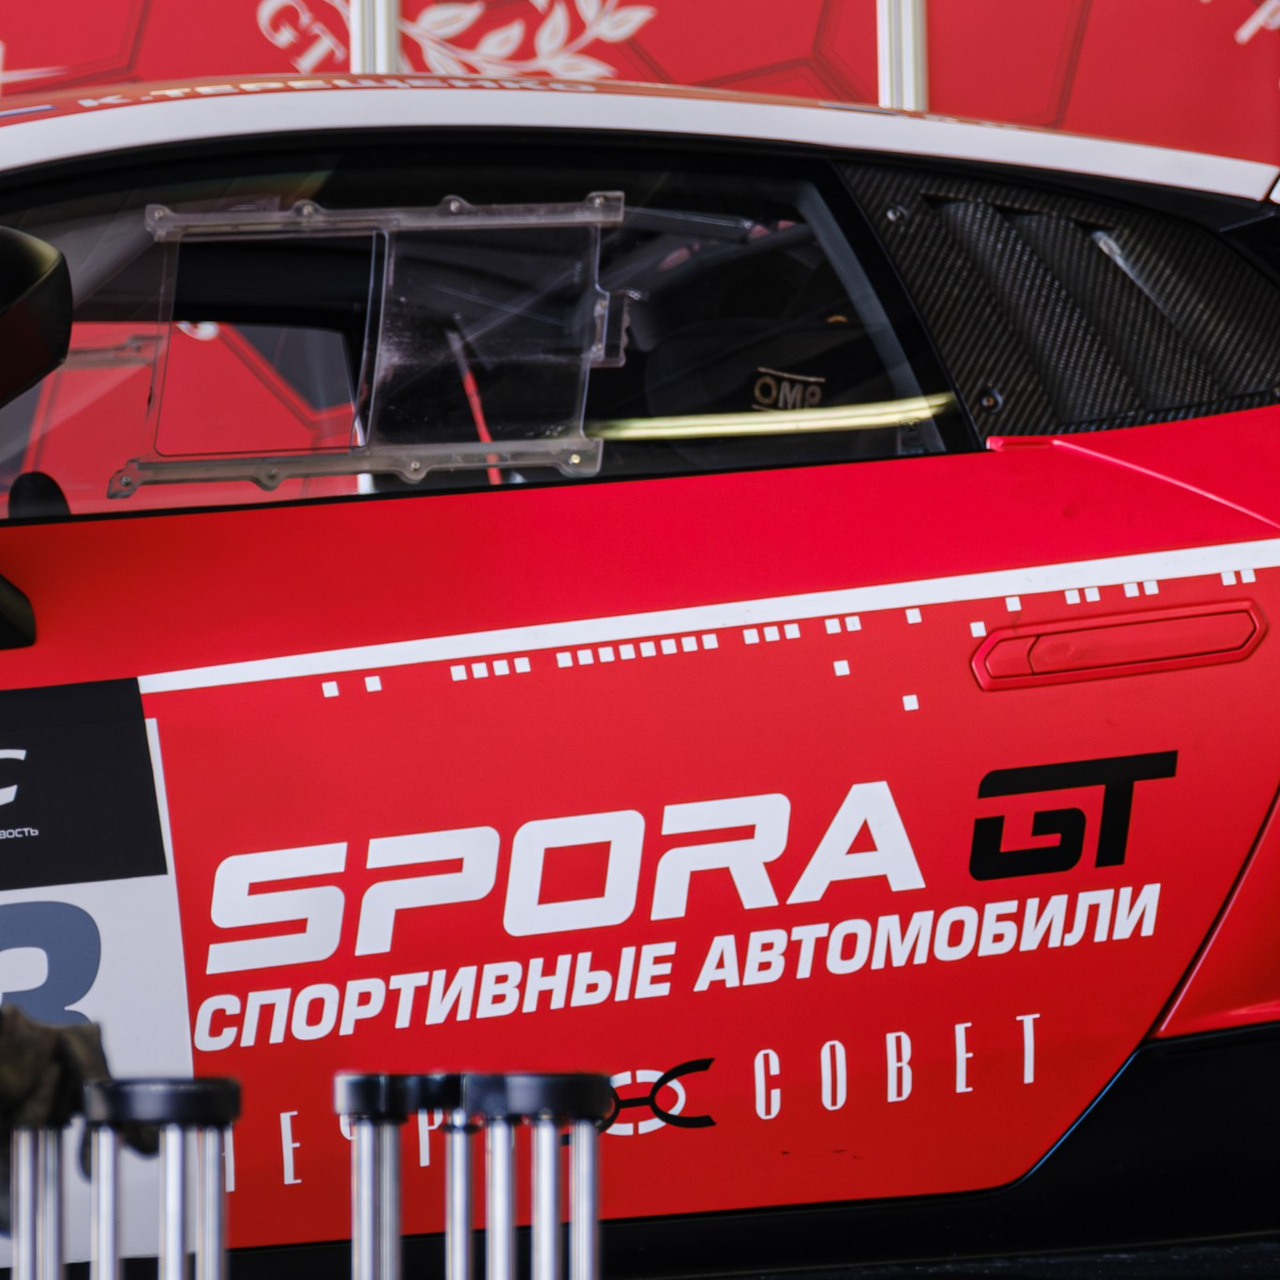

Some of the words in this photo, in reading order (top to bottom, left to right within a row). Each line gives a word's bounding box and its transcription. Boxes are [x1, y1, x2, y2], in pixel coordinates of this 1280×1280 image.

[754, 376, 823, 410] OMP
[205, 781, 926, 975] SPORA
[969, 750, 1178, 882] GT
[194, 942, 676, 1052] СПОРТИВНЫЕ
[693, 883, 1161, 993] АВТОМОБИЛИ
[754, 1013, 1042, 1120] СОВЕТ
